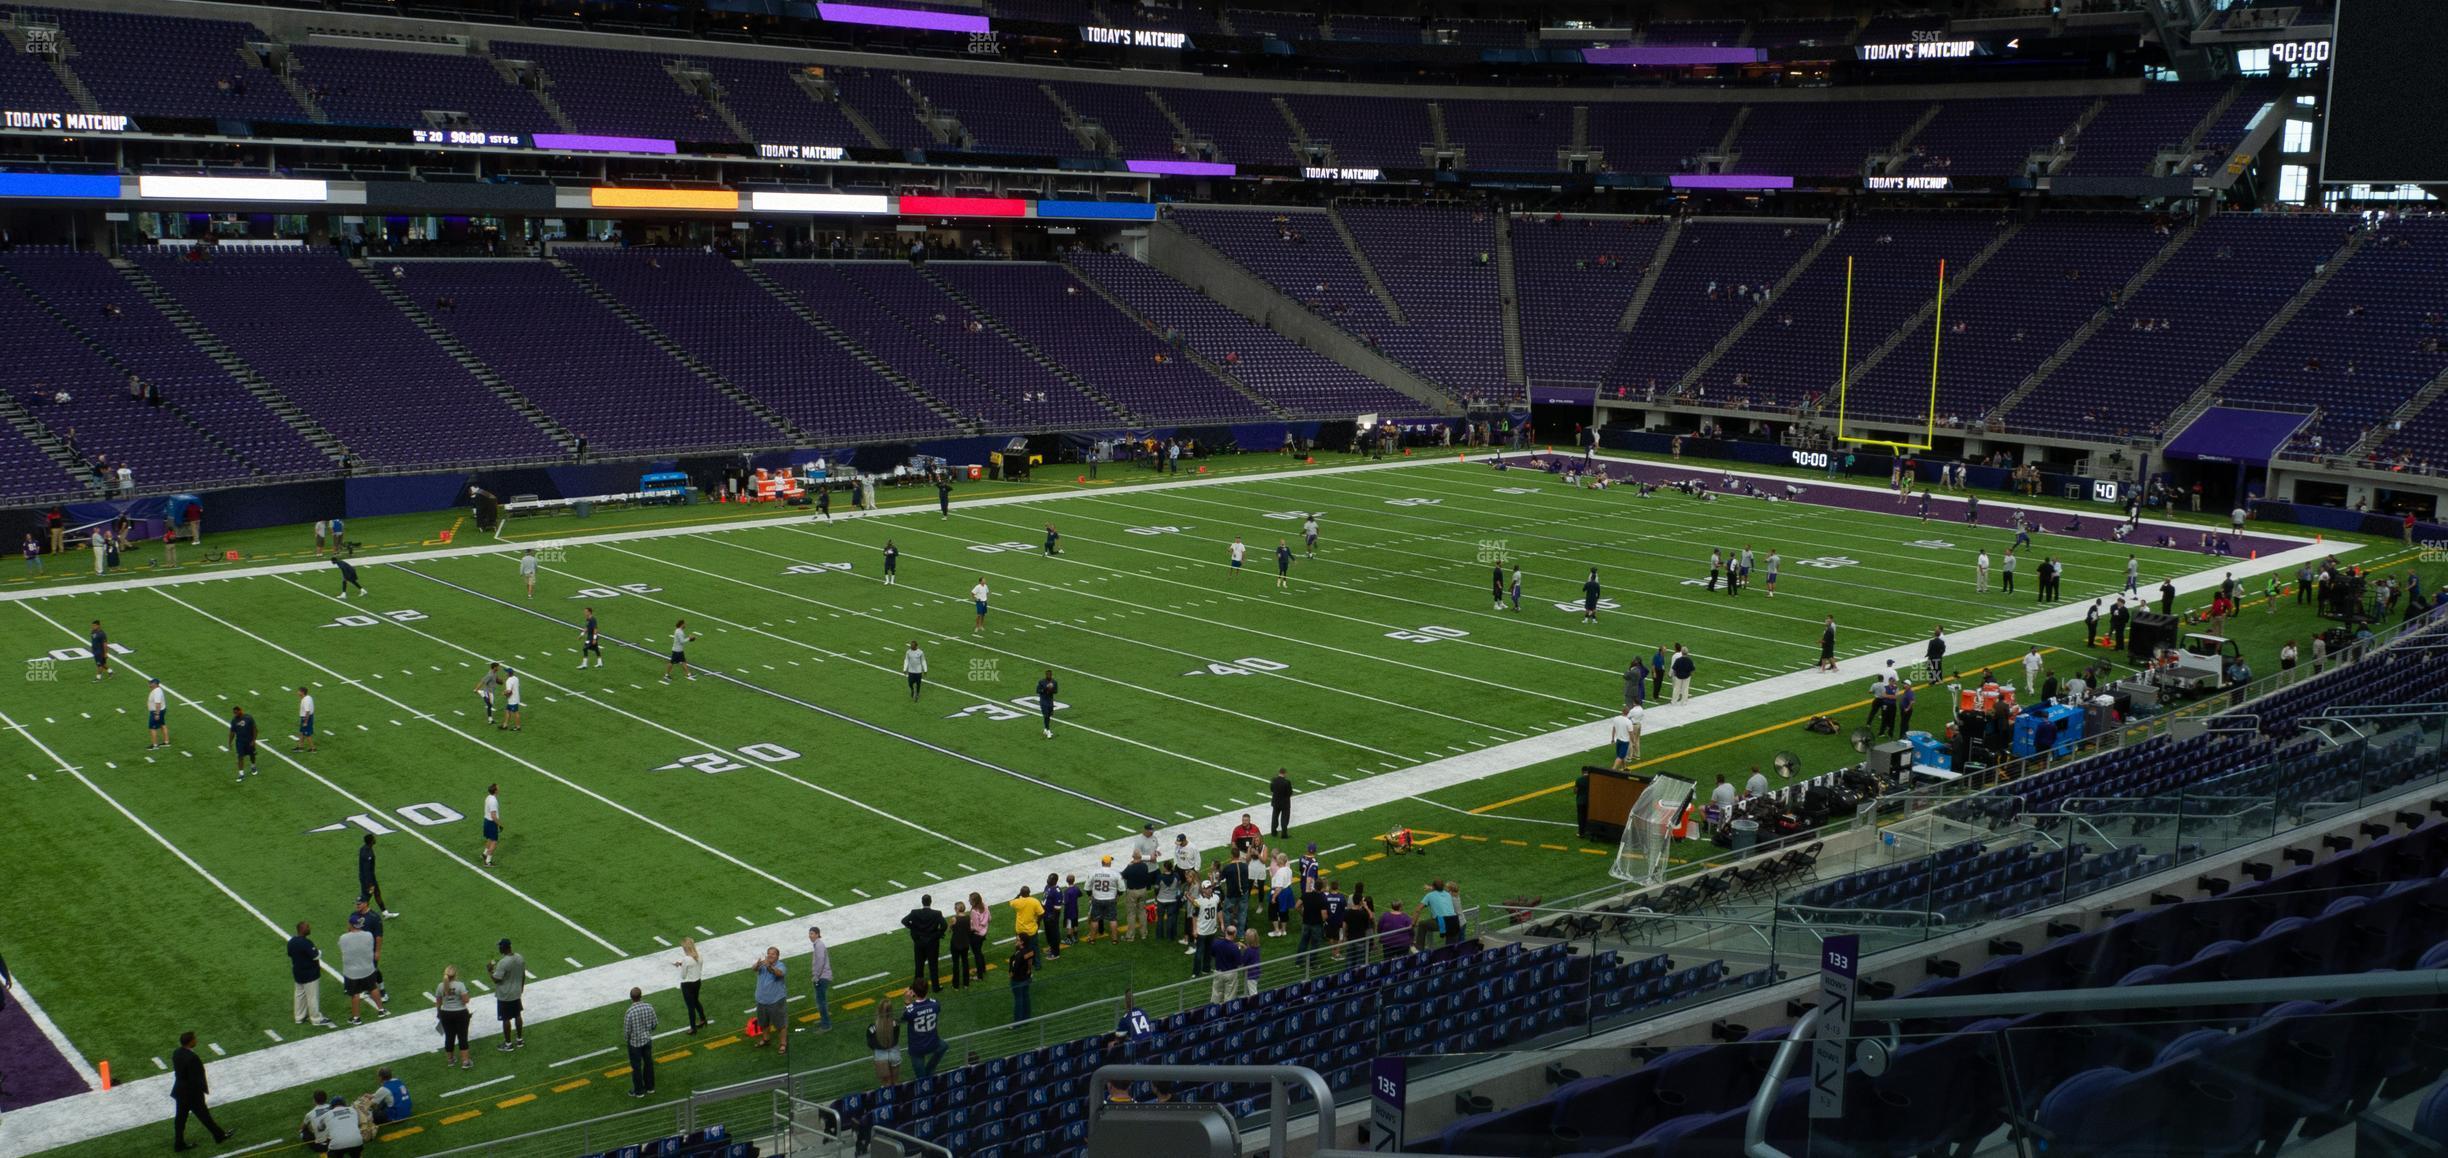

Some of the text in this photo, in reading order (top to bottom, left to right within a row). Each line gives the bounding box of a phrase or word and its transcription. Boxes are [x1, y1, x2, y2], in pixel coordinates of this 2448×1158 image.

[1087, 26, 1186, 49] TODAY'S MATCHUP
[1864, 44, 1914, 60] TODAY'S
[1918, 41, 1975, 58] MATCHUP
[2272, 41, 2330, 62] 90:00
[4, 111, 128, 131] TODAY'S MATCHUP
[429, 131, 443, 142] 20
[450, 131, 486, 144] 90:00
[488, 135, 503, 144] 1ST
[760, 144, 843, 160] TODAY'S MATCHUP
[1305, 168, 1379, 180] TODAY'S MATCHUP
[1868, 177, 1948, 189] TODAY'S MATCHUP
[1792, 450, 1828, 467] 90:00
[2096, 484, 2116, 499] 40
[577, 583, 663, 598] 30
[333, 609, 430, 627] 20
[1384, 625, 1471, 644] 50
[1206, 657, 1290, 676] 40
[962, 695, 1072, 721] 30
[678, 742, 801, 774] 20
[346, 802, 465, 836] 10
[1094, 879, 1111, 892] 28
[1204, 906, 1216, 921] 30
[1828, 951, 1849, 970] 133
[913, 1012, 937, 1033] 22
[1131, 1015, 1150, 1035] 14
[1377, 1075, 1397, 1098] 135
